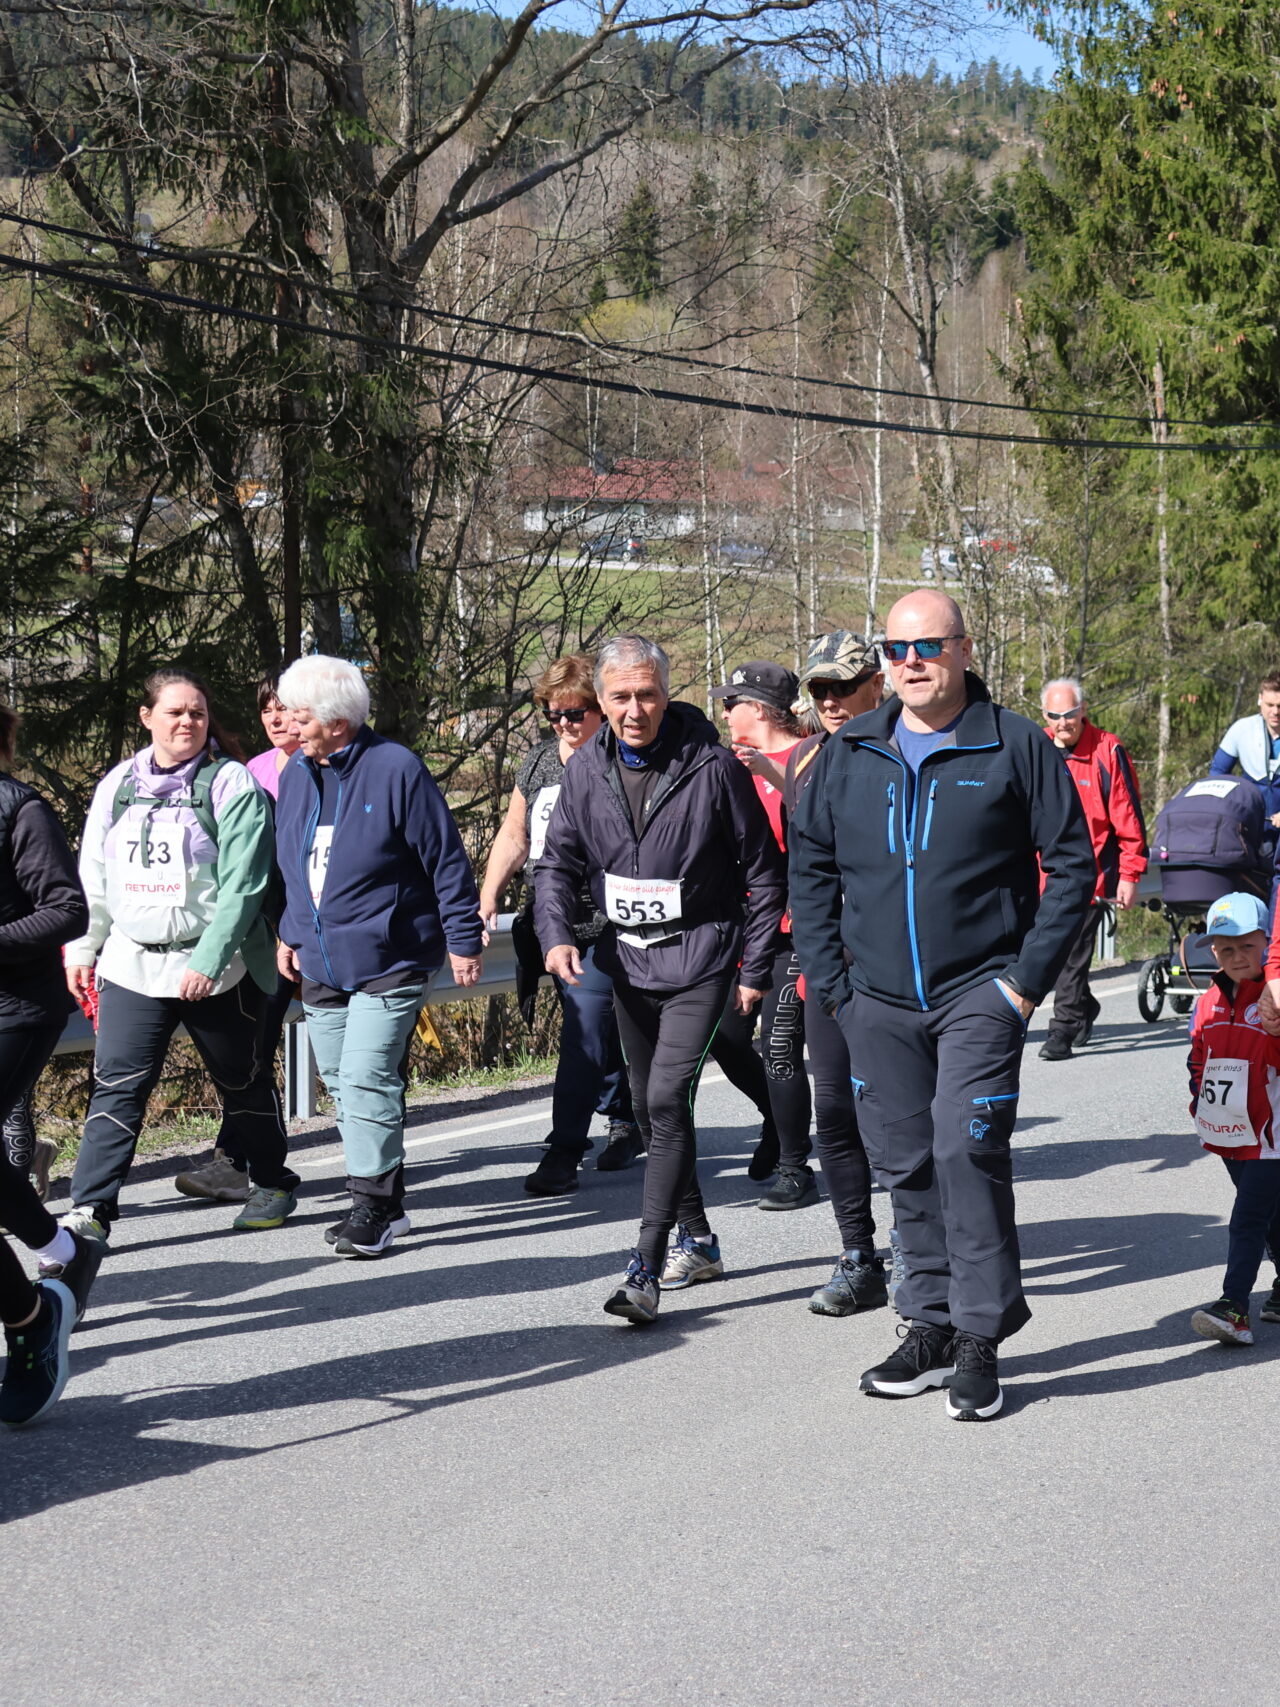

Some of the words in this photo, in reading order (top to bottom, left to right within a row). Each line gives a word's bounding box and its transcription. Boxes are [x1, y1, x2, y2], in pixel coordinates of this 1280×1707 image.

[126, 841, 171, 864] 723
[125, 883, 176, 893] RETURA
[616, 898, 667, 921] 553
